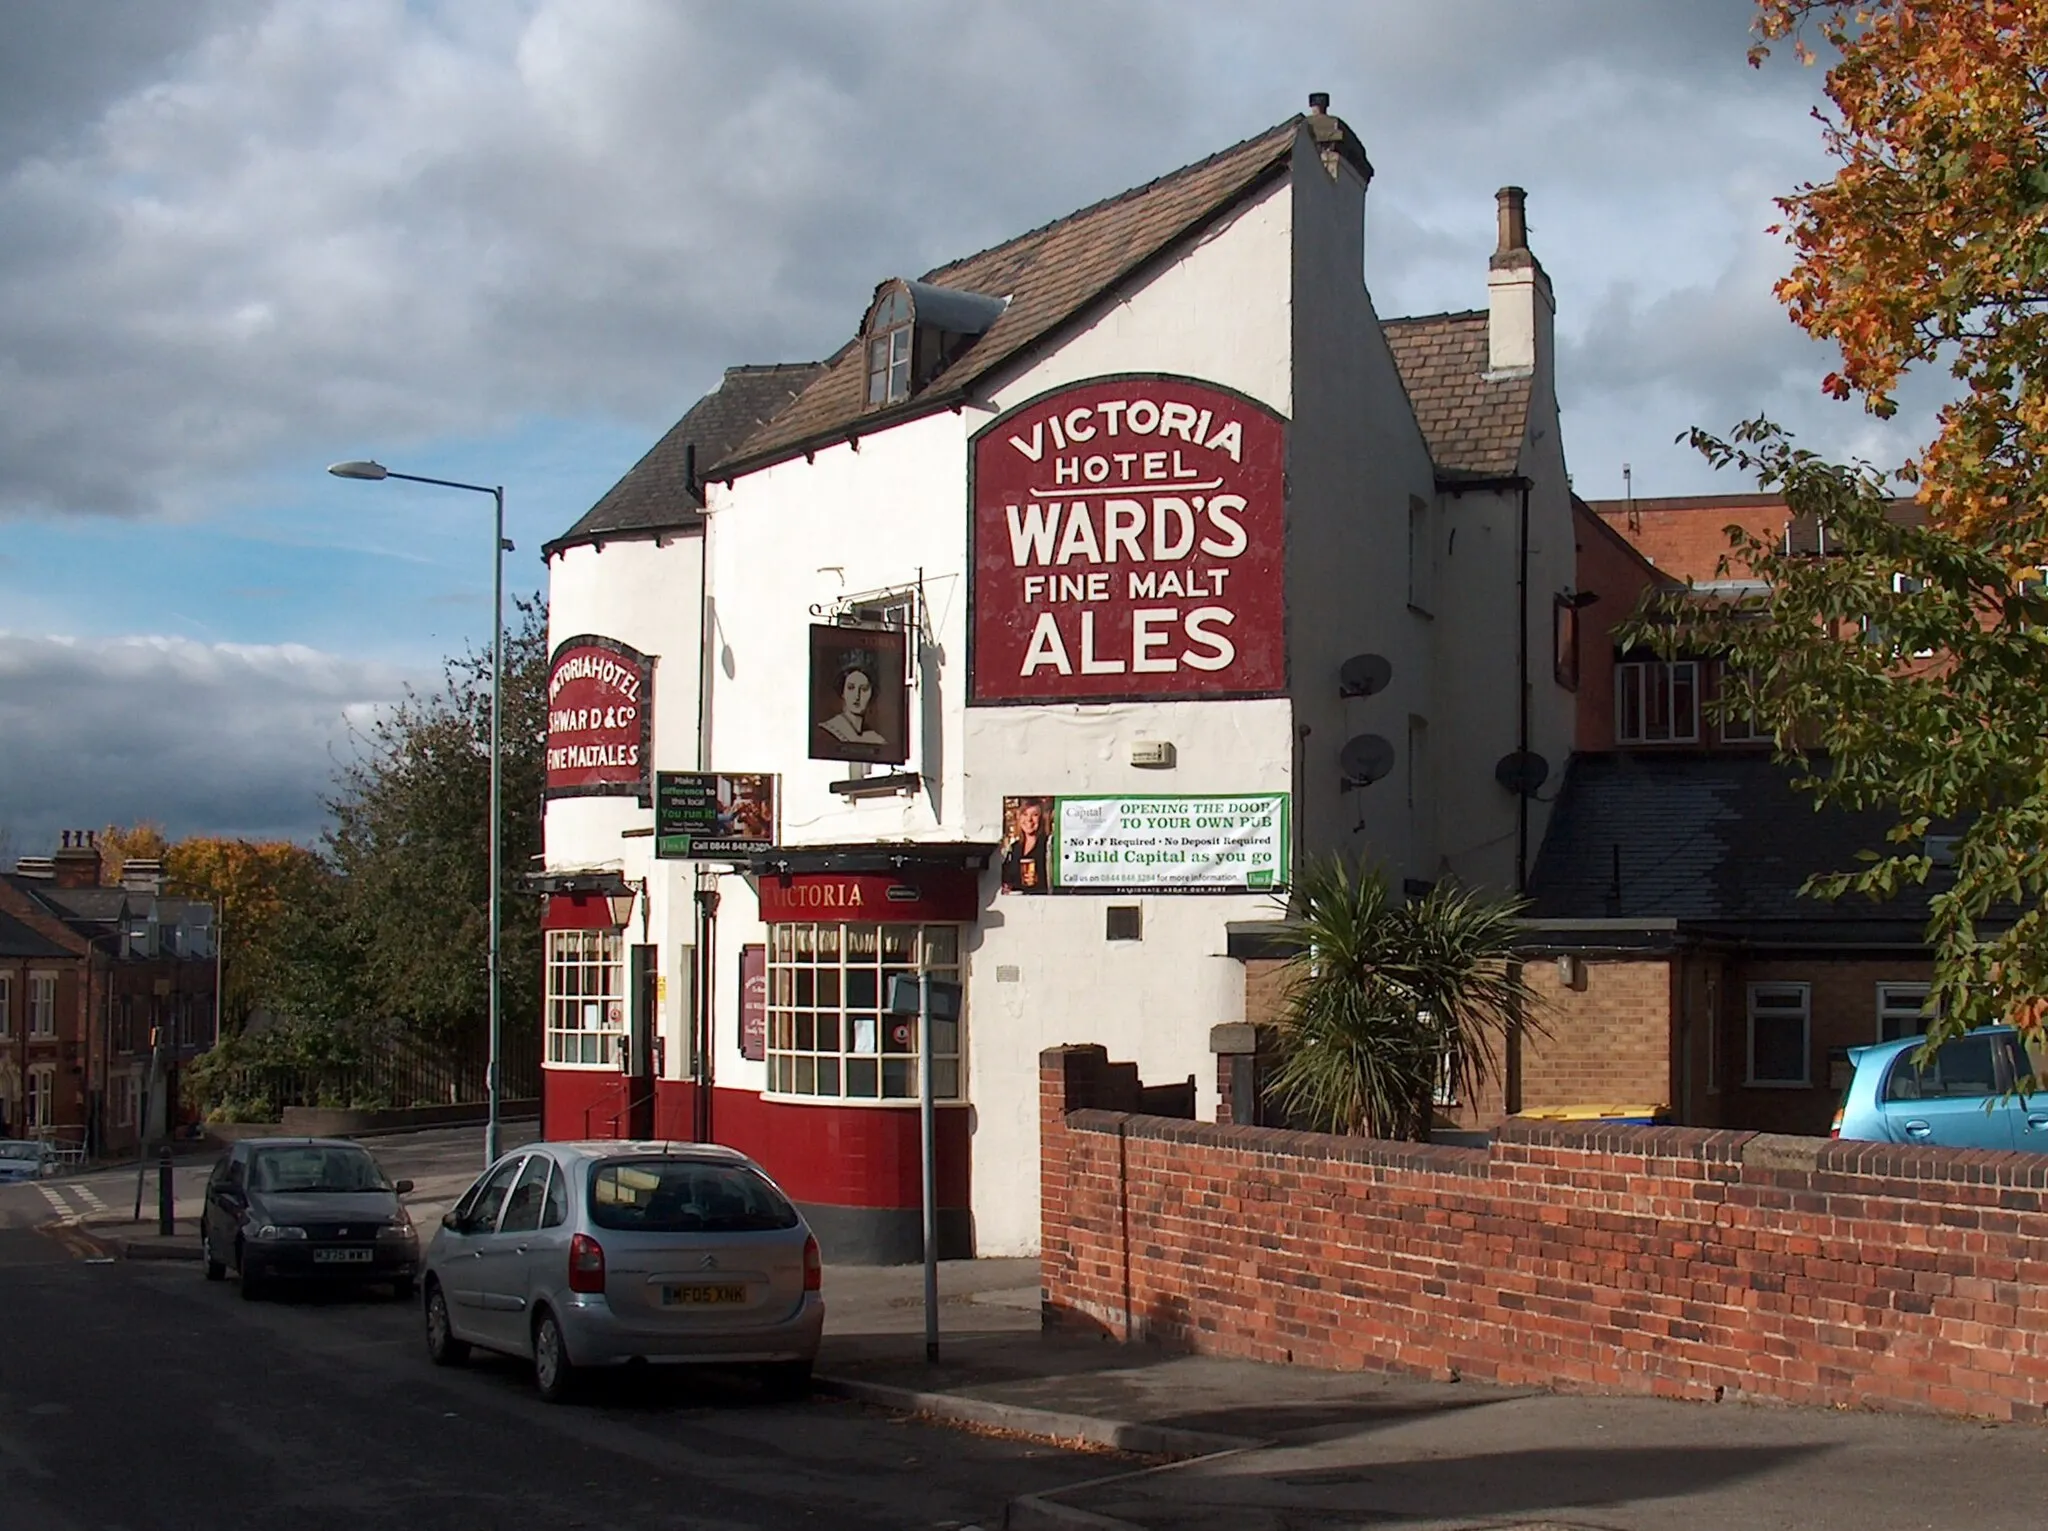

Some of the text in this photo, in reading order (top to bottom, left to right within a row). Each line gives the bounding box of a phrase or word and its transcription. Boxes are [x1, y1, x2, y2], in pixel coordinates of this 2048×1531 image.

[1008, 399, 1242, 463] VICTORIA
[1055, 450, 1198, 484] HOTEL
[1005, 494, 1248, 567] WARD'S
[1024, 568, 1230, 603] FINE MALT
[1020, 606, 1236, 677] ALES
[592, 656, 640, 703] HOTEL
[568, 745, 600, 769] MALT
[597, 744, 639, 766] ALES
[705, 788, 716, 796] to
[1066, 806, 1102, 820] Capital
[1120, 803, 1189, 815] OPENING
[1193, 803, 1224, 814] THE
[1120, 818, 1142, 829] TO
[1146, 817, 1192, 829] YOUR
[1196, 816, 1234, 829] OWN
[1240, 816, 1272, 828] PUB
[692, 841, 708, 851] Call
[1070, 838, 1084, 846] No
[1110, 837, 1156, 848] Required
[1164, 837, 1179, 846] No
[1181, 837, 1220, 848] Deposit
[1223, 836, 1271, 847] Required
[1074, 850, 1272, 866] Build Capital as you go
[1063, 874, 1078, 882] Call
[1157, 873, 1168, 882] for
[1169, 874, 1189, 882] more
